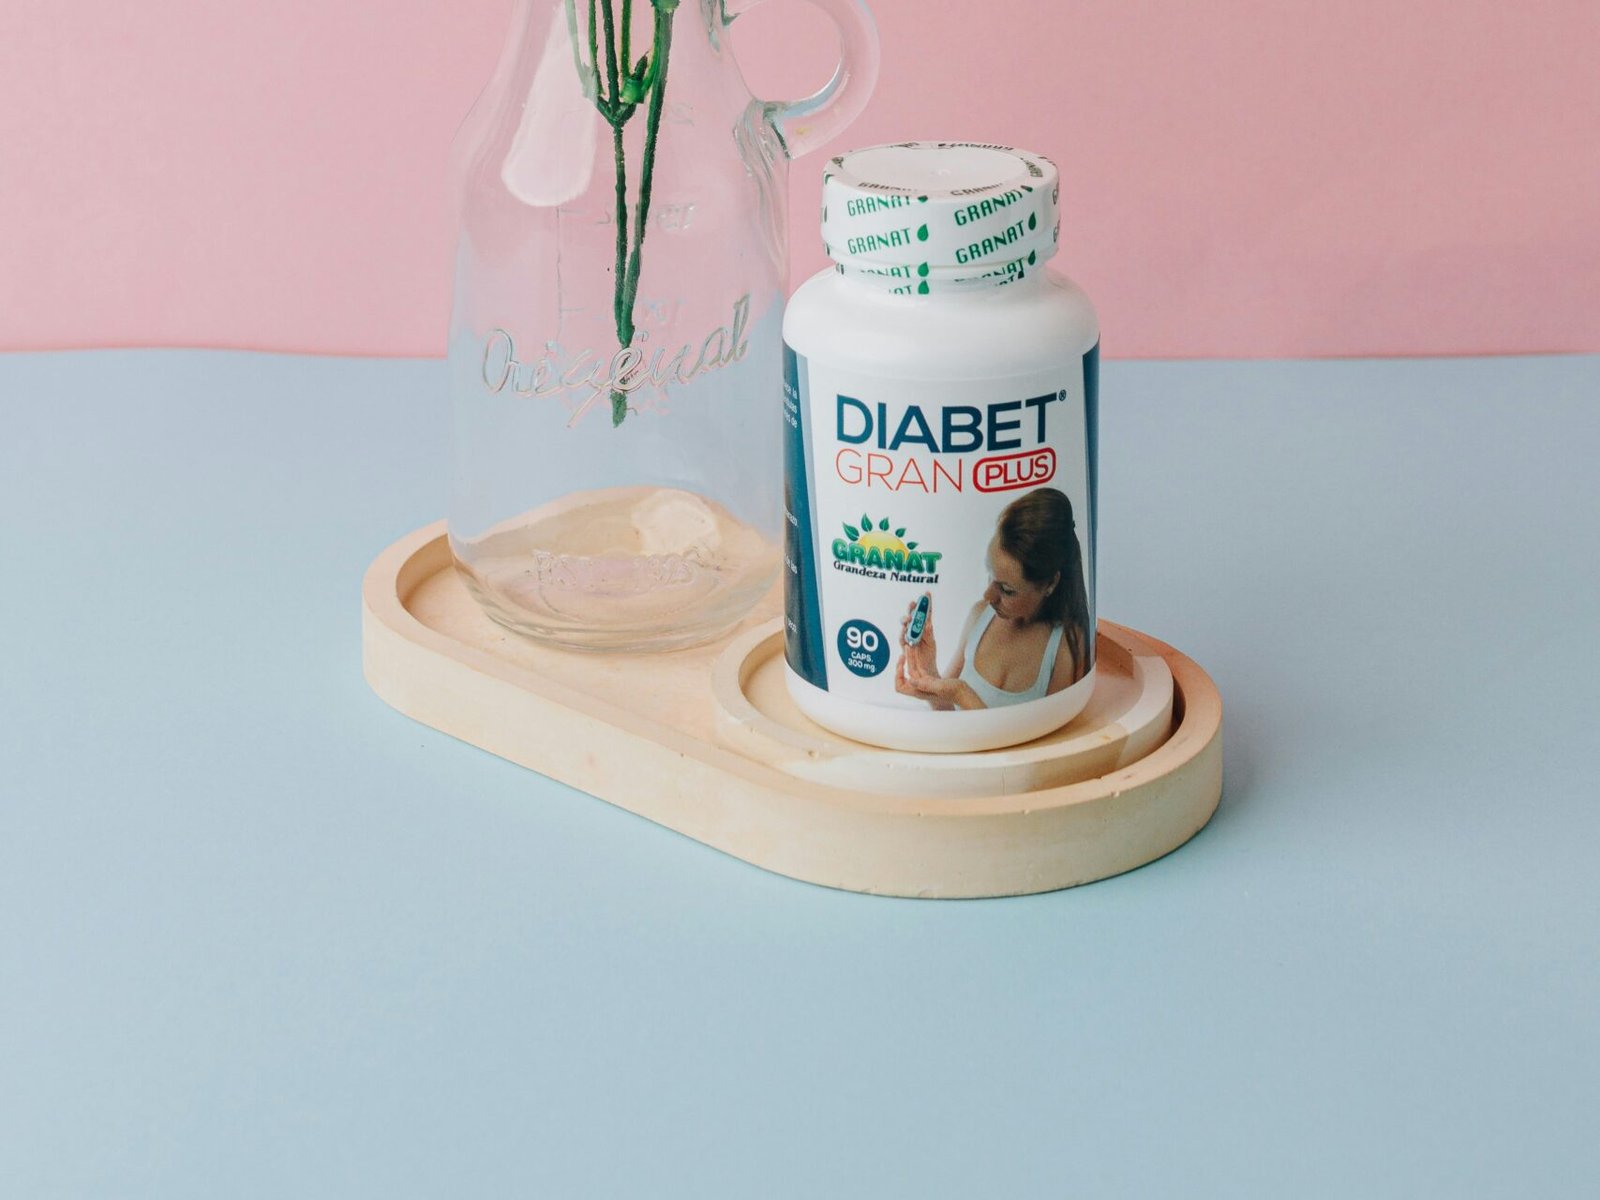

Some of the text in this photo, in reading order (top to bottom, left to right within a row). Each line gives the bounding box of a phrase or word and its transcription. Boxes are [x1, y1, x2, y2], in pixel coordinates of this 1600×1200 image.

[847, 227, 911, 255] GRANAT
[955, 220, 1024, 264] GRANAT
[835, 448, 1050, 493] GRAN PLUS
[831, 538, 943, 574] GRANAT
[833, 559, 940, 584] Grandeza Natural
[846, 626, 879, 652] 90
